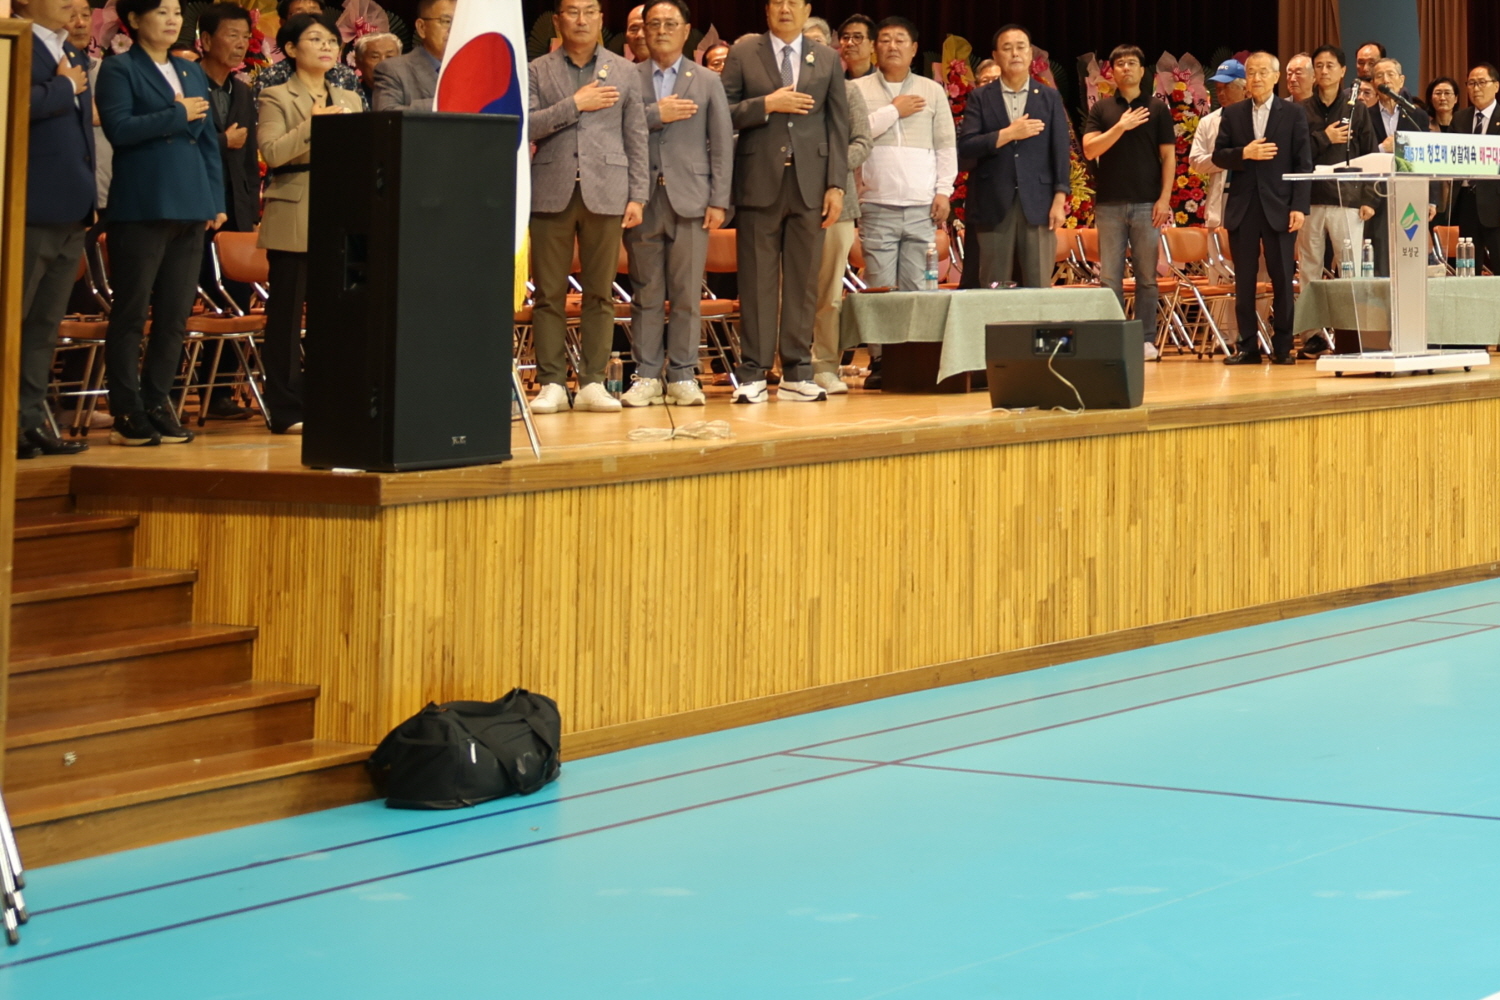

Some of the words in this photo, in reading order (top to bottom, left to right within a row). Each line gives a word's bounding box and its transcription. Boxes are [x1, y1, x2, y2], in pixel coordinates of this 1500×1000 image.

[1427, 143, 1448, 164] 청호배
[1450, 145, 1477, 165] 생활체육
[1402, 246, 1419, 258] 보성군
